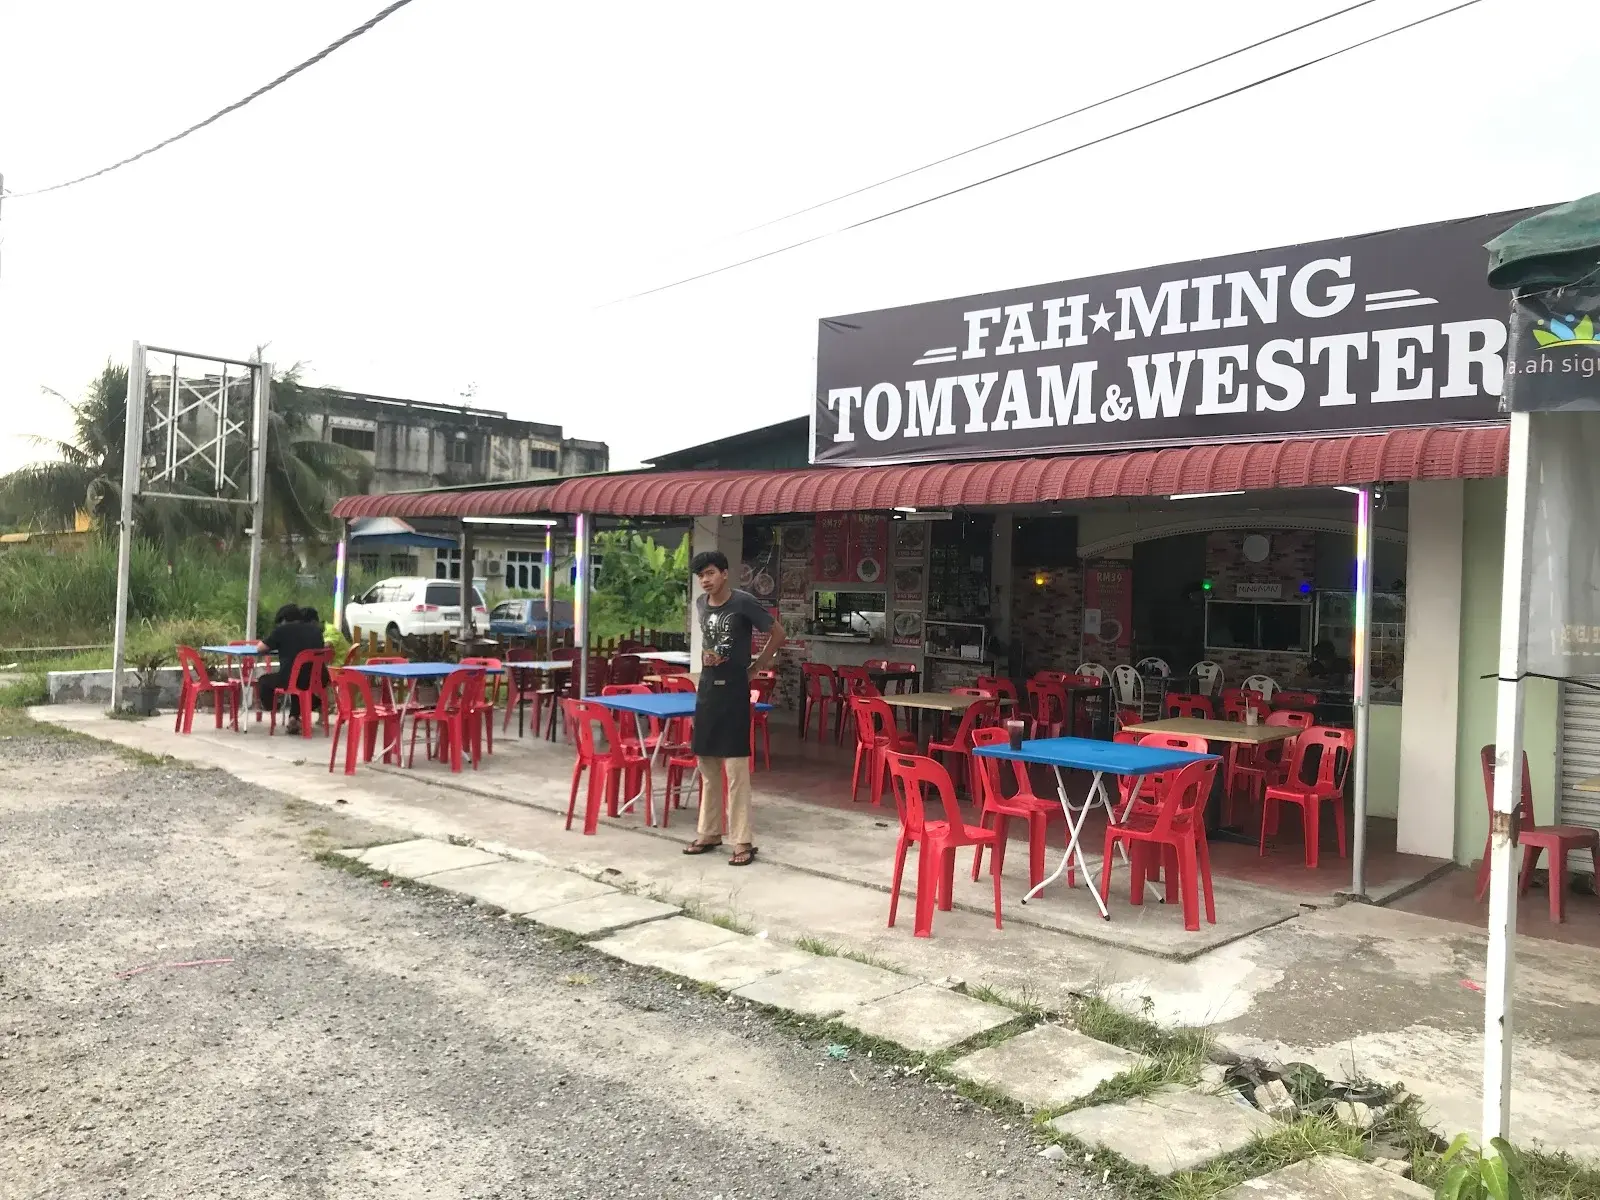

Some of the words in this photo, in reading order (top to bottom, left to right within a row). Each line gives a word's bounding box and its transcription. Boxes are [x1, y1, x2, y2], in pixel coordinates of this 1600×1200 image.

[962, 294, 1089, 361] FAH
[1114, 256, 1356, 341] MING
[828, 361, 1098, 442] TOMYAM
[1100, 384, 1133, 422] &
[1561, 354, 1600, 378] sig
